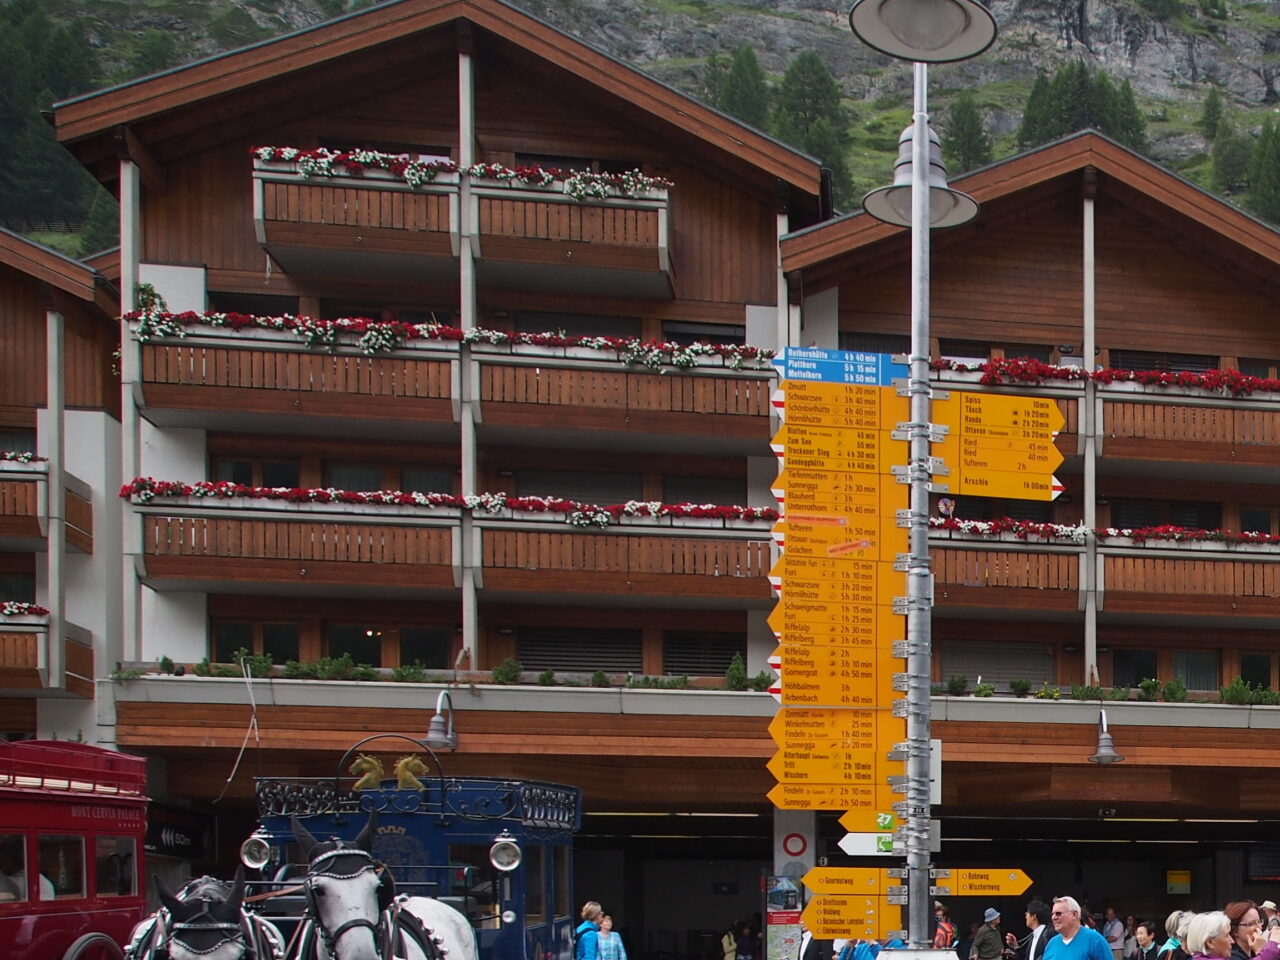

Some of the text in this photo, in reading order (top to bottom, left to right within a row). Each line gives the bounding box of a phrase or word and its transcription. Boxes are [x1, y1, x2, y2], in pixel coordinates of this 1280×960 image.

[788, 360, 816, 369] Platthorn
[788, 370, 821, 379] Mettelhorn
[788, 393, 822, 401] Schwarzsee
[966, 396, 980, 404] Spiss
[964, 459, 987, 468] Tufteren
[788, 471, 827, 480] Tiefenmatten
[788, 481, 818, 490] Sunnegga
[788, 492, 815, 500] Blauherd
[788, 503, 827, 511] Unterrothorn
[788, 524, 812, 532] Tufteren
[785, 634, 814, 644] Riffelberg
[785, 648, 810, 656] Riffelalp
[785, 658, 814, 667] Riffelberg
[785, 668, 817, 677] Gornergrat
[71, 806, 140, 820] MONT CERVIN PALACE
[877, 813, 892, 824] 27
